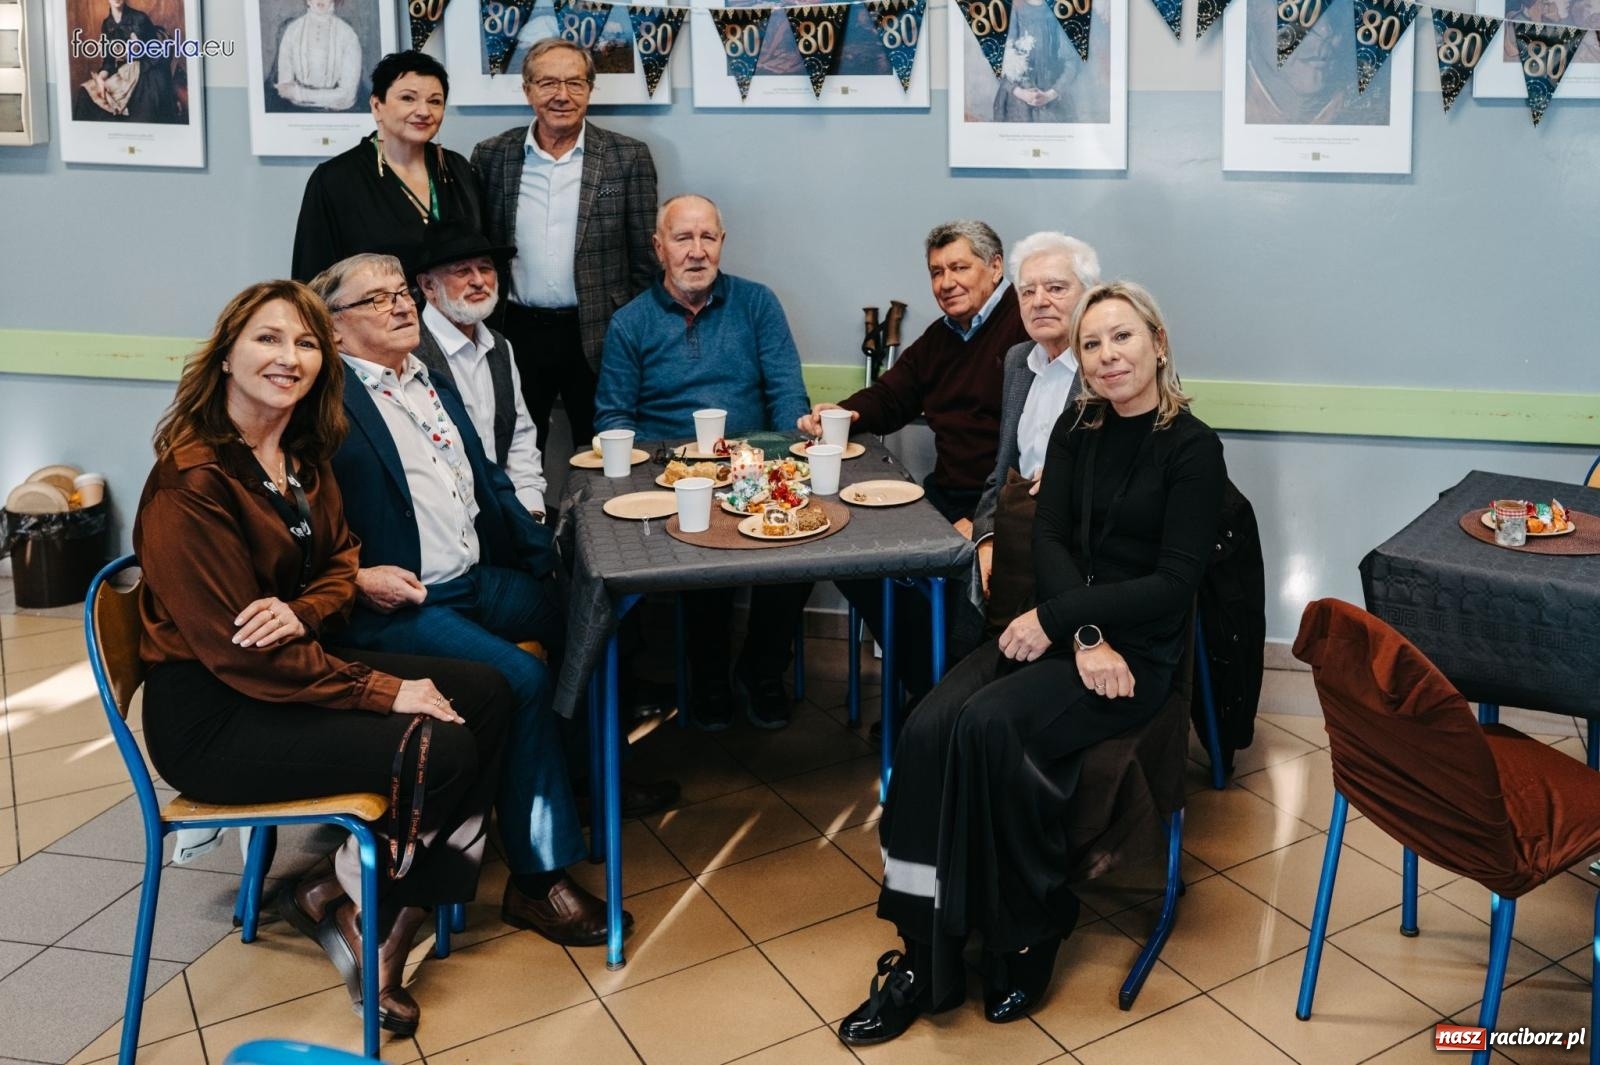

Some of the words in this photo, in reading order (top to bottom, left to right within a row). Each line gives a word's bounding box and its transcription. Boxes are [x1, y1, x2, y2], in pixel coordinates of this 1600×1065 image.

[484, 1, 520, 37] 80
[562, 13, 597, 49] 80
[881, 13, 918, 49] 80
[969, 0, 1008, 36] 80
[1278, 0, 1317, 28] 80
[1356, 9, 1400, 51] 80
[638, 21, 673, 56] 80
[725, 23, 760, 57] 80
[798, 20, 834, 54] 80
[1438, 27, 1483, 68] 80
[1524, 40, 1567, 80] 80
